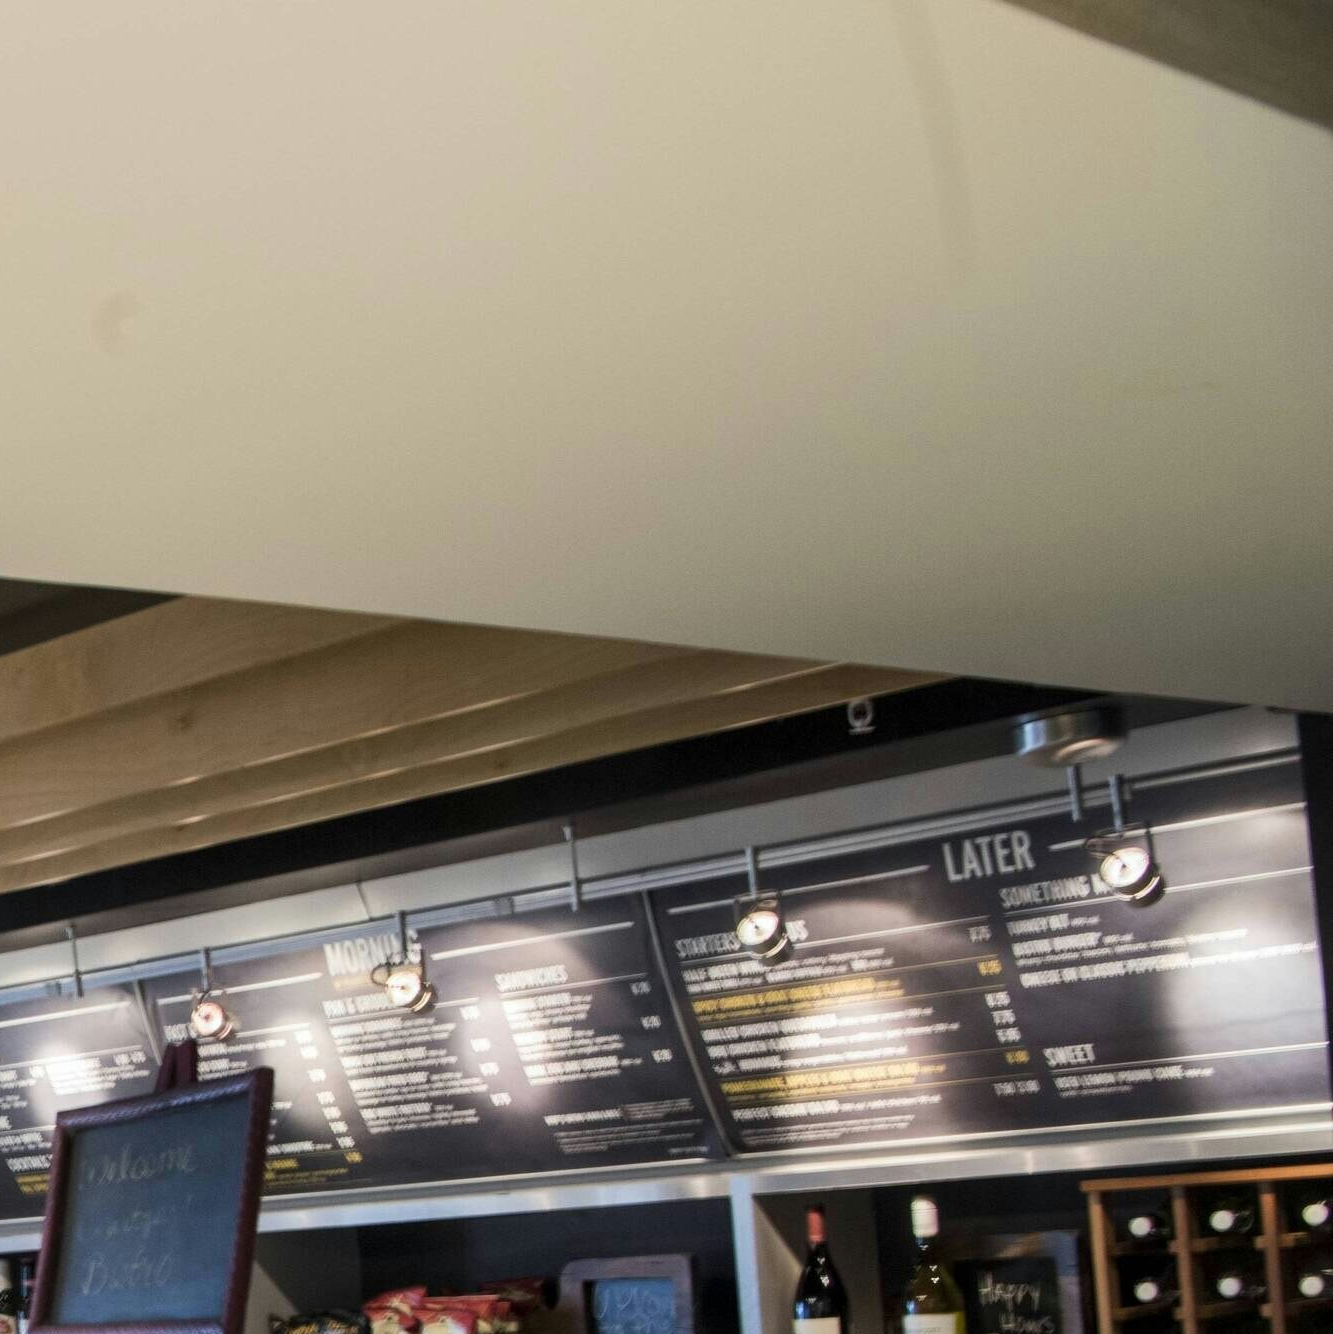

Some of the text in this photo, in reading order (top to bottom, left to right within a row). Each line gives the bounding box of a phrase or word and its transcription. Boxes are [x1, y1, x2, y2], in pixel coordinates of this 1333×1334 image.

[942, 830, 1036, 883] LATER
[998, 874, 1090, 909] SOMETHING
[1043, 1043, 1096, 1067] SWEET
